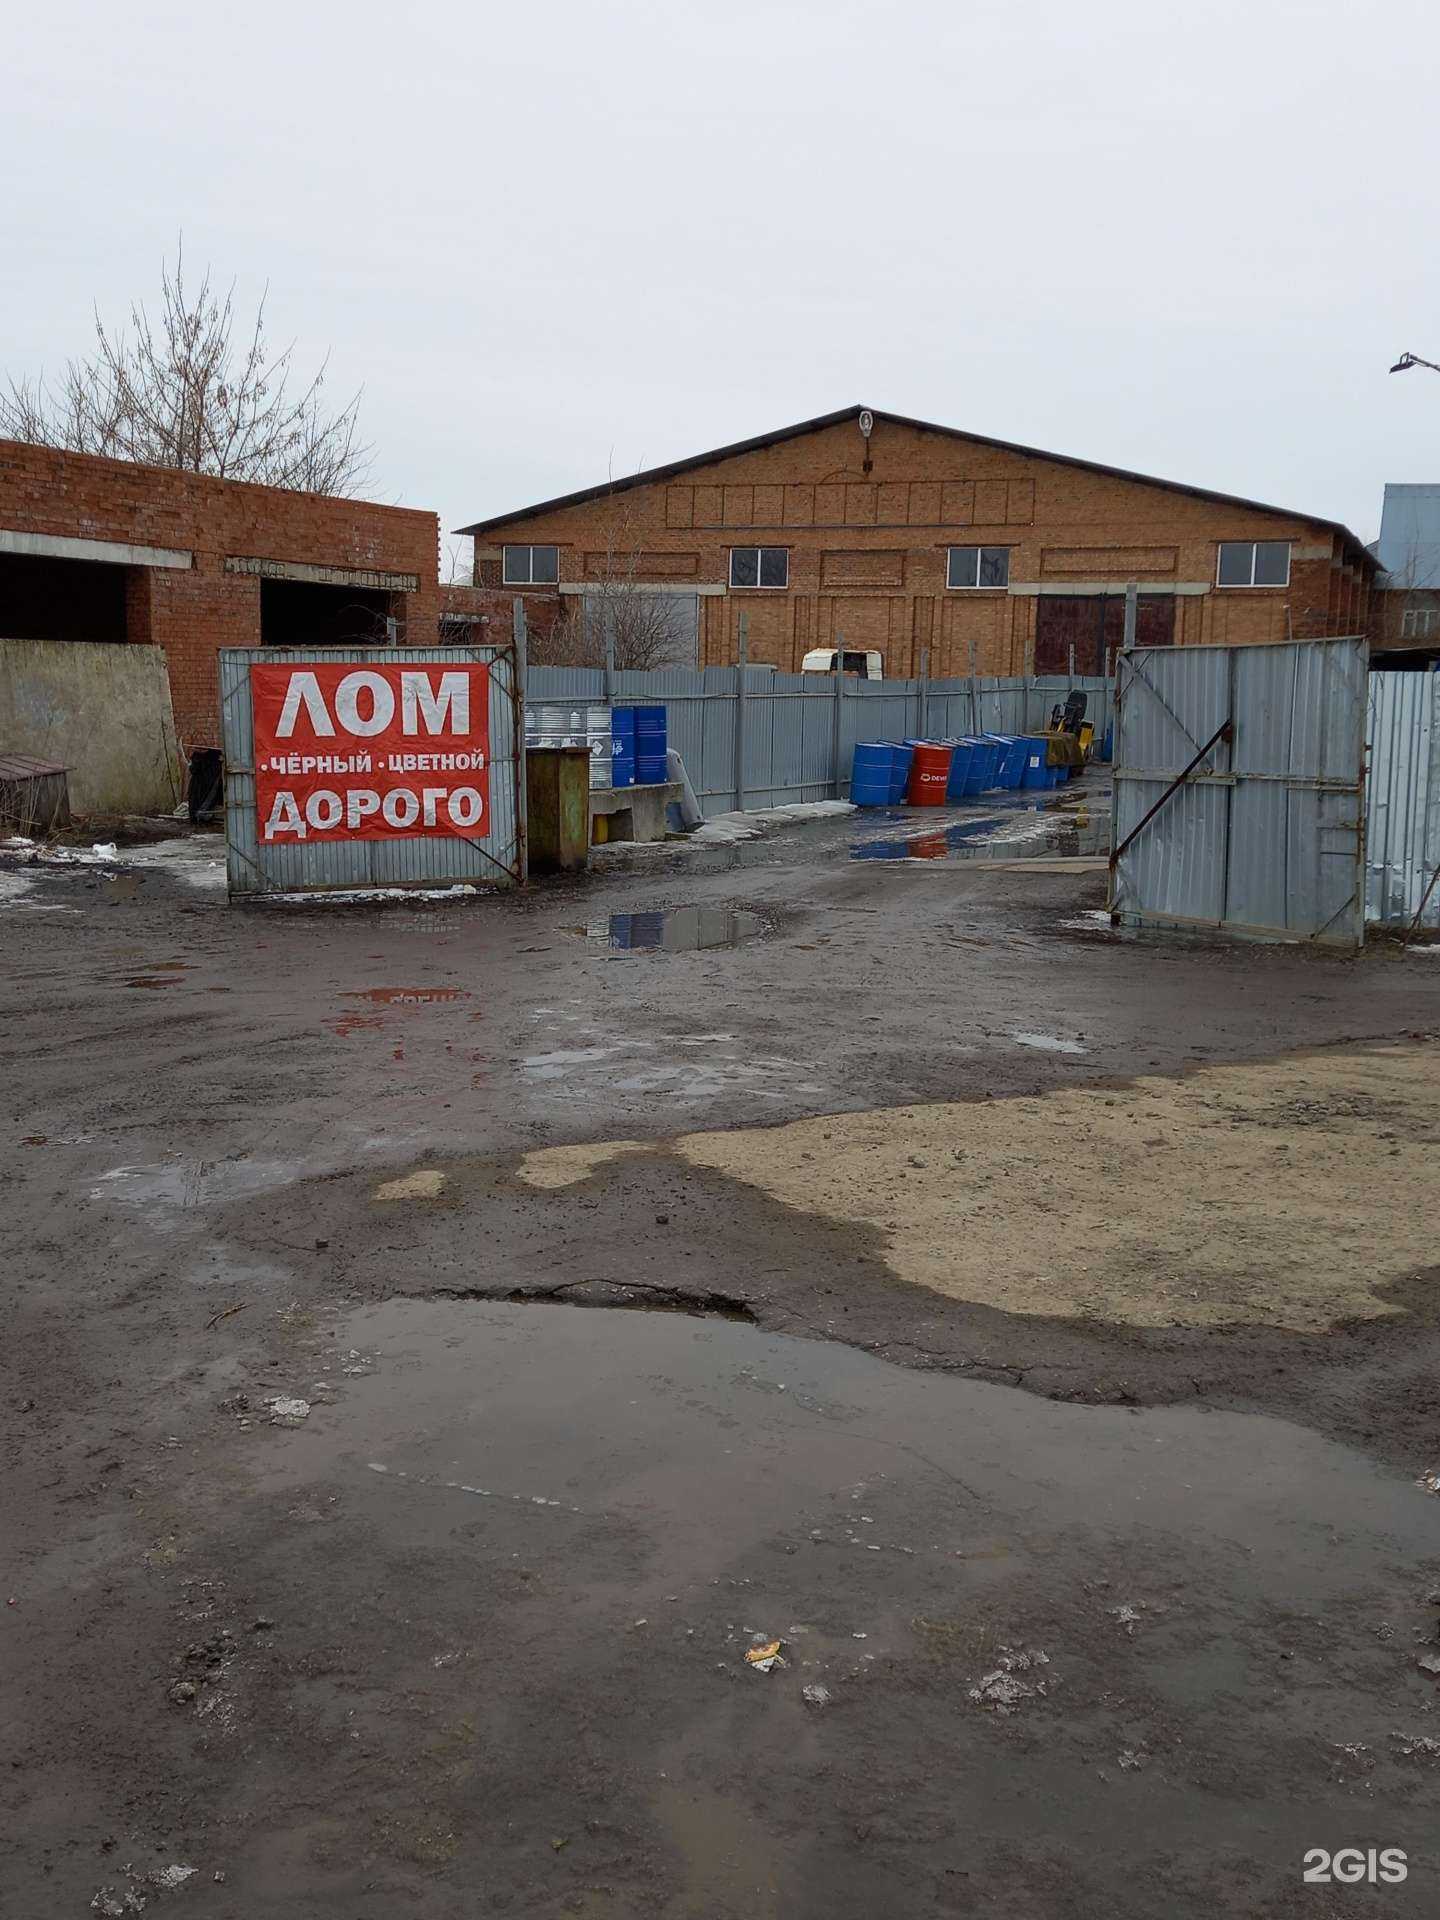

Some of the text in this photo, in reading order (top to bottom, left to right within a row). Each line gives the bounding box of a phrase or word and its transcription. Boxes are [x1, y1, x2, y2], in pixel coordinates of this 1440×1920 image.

[275, 671, 470, 737] ЛОМ
[388, 748, 485, 773] ЦВЕТНОЙ
[264, 787, 483, 839] ДОРОГО
